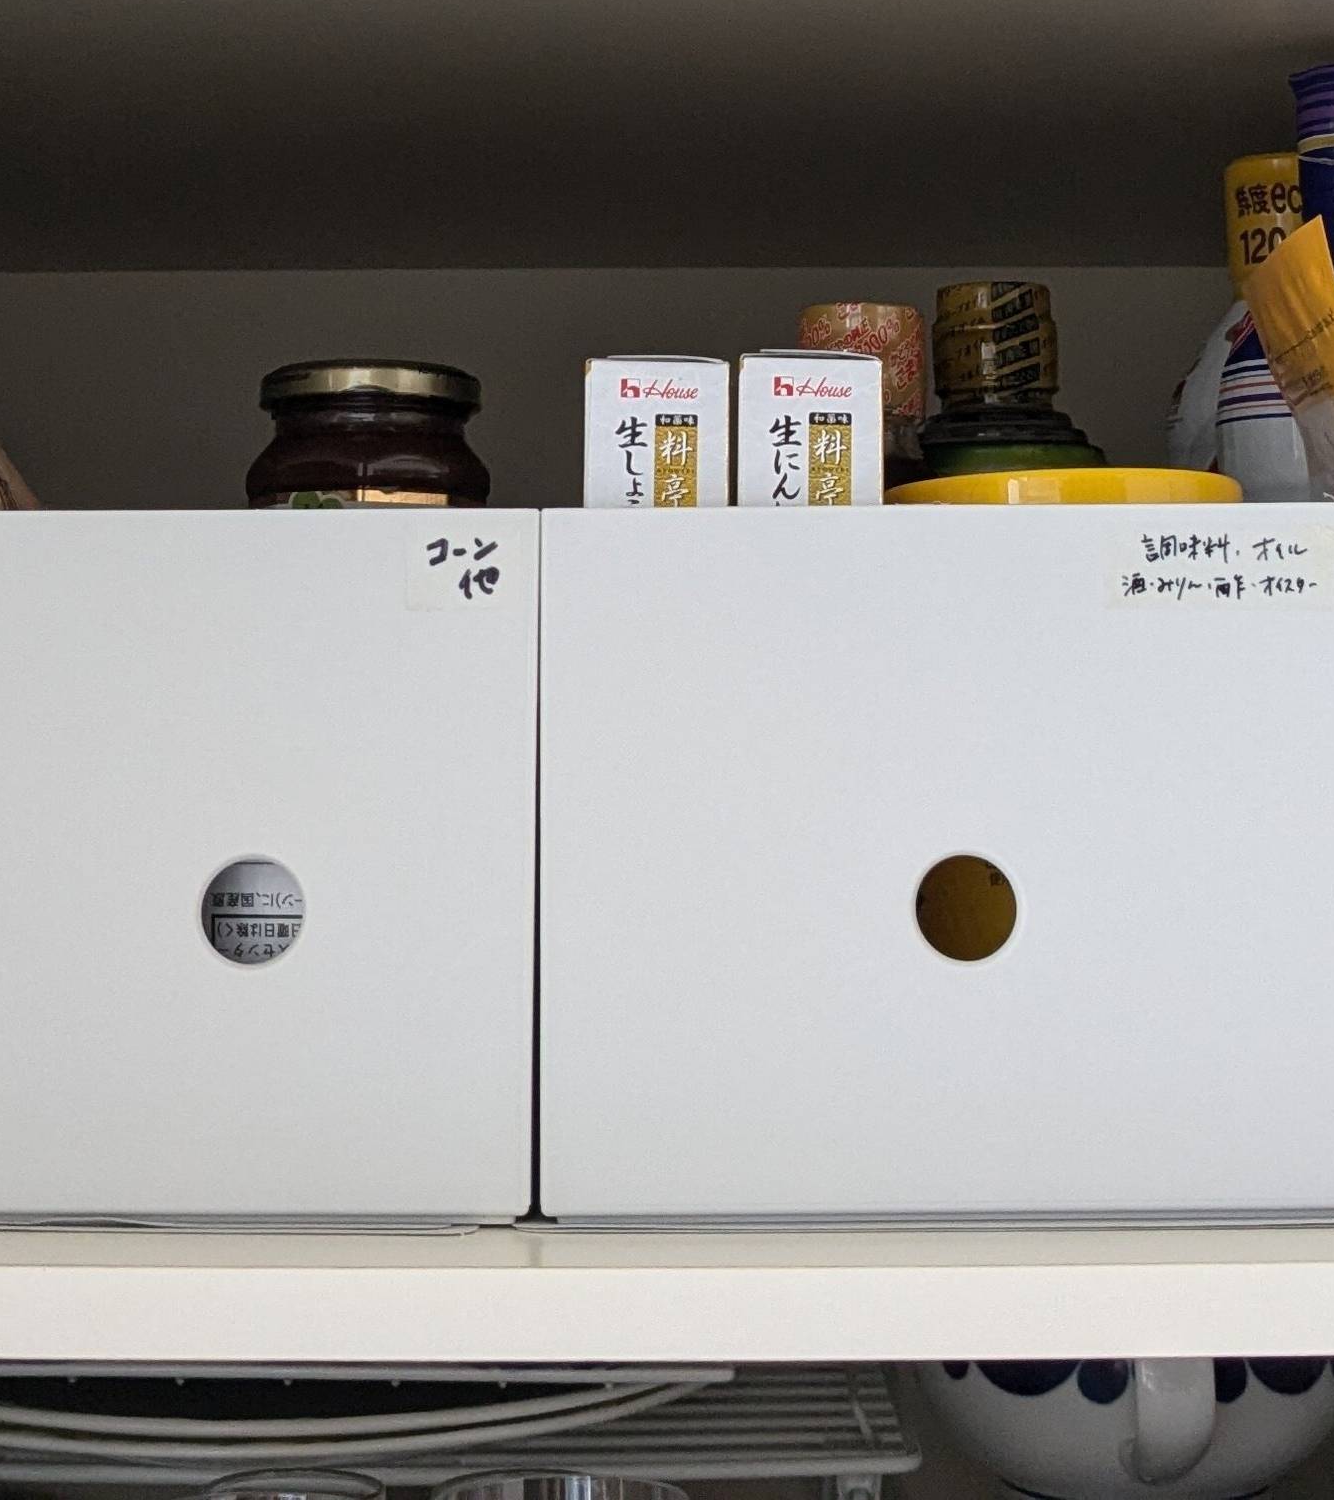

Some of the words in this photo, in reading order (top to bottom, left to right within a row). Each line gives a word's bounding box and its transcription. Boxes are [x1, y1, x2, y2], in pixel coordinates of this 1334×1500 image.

[643, 379, 699, 399] House
[796, 377, 853, 398] House
[769, 415, 802, 506] 生にん
[427, 537, 498, 566] コーン
[459, 567, 499, 600] 他
